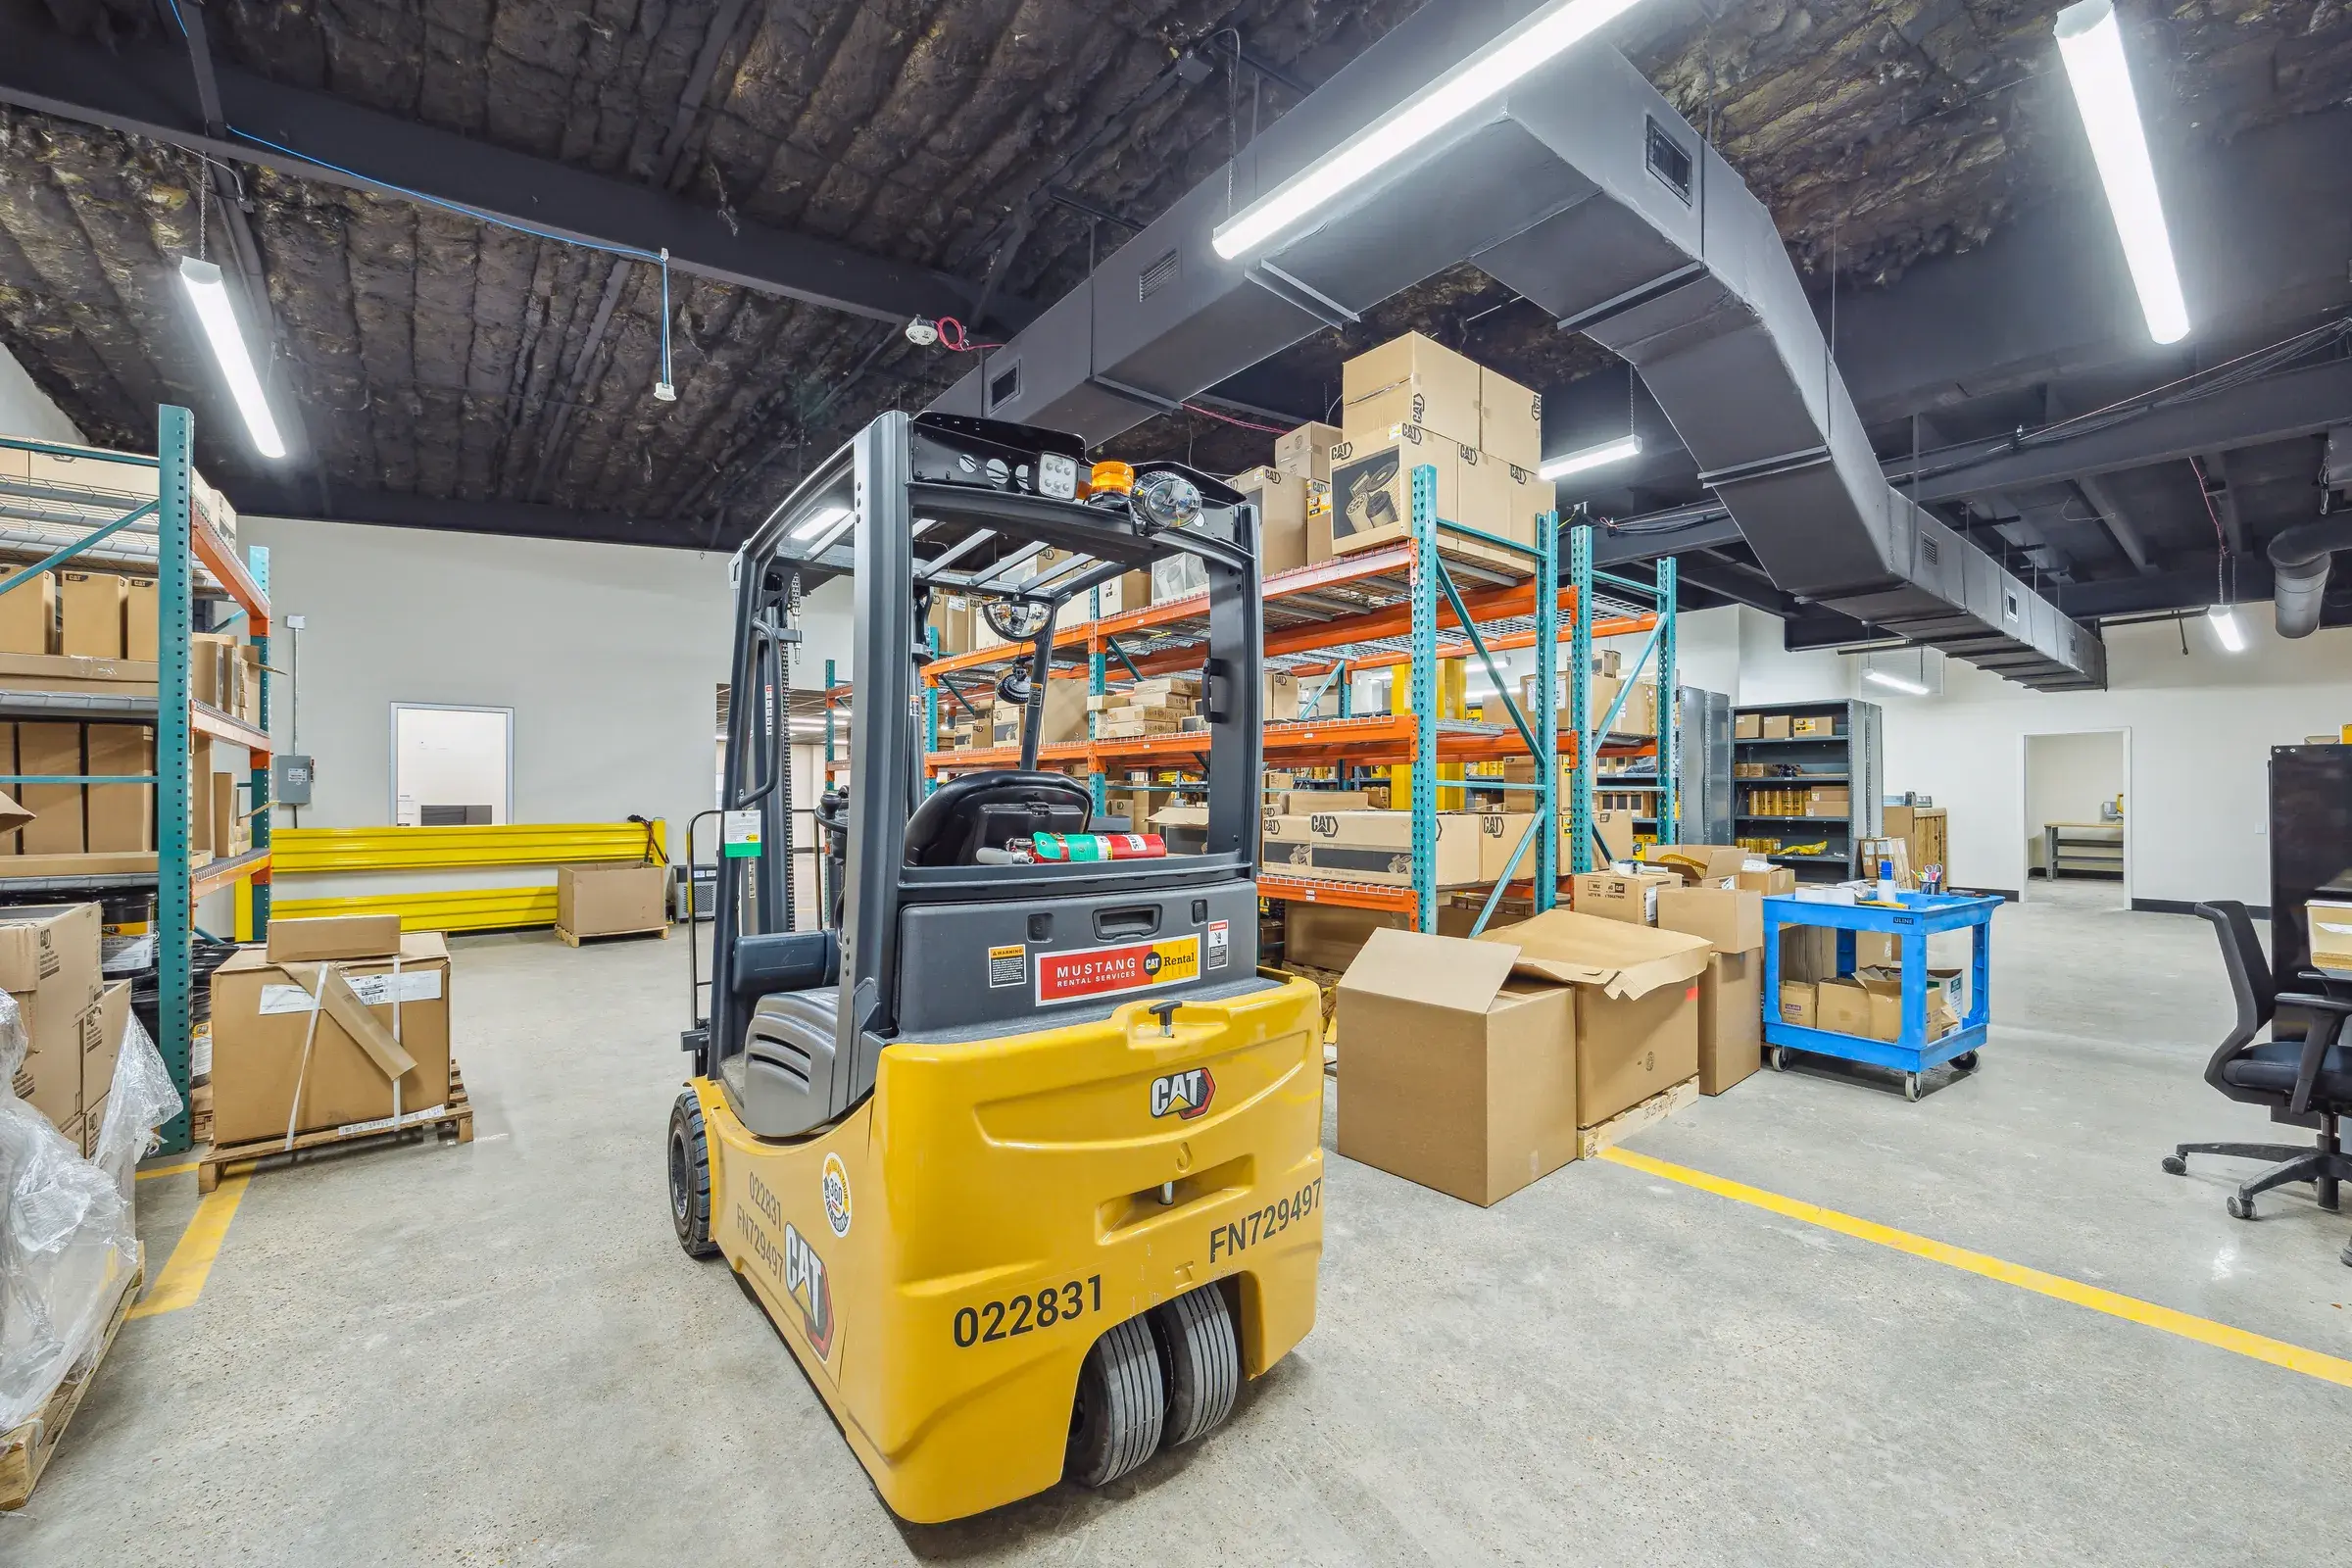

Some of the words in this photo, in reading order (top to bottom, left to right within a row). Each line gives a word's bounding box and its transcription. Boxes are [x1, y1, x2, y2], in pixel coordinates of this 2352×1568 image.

[1412, 399, 1424, 423] CAT
[1402, 422, 1418, 440] CAT
[1331, 443, 1348, 461] CAT
[1460, 444, 1476, 462] CAT
[1265, 469, 1278, 482] CAT
[1510, 465, 1526, 481] CAT
[1313, 481, 1325, 492] CAT
[1264, 819, 1277, 831] CAT
[1312, 815, 1332, 832] CAT
[1484, 816, 1499, 833] CAT
[1056, 957, 1136, 978] MUSTANG
[1146, 957, 1159, 969] CAT
[1163, 953, 1195, 967] Rental
[1056, 978, 1092, 988] RENTAL
[1096, 970, 1136, 982] SERVICES
[1152, 1069, 1201, 1116] CAT
[830, 1178, 842, 1206] 360
[750, 1171, 782, 1232] 022831
[1209, 1176, 1322, 1264] FN729497
[737, 1203, 784, 1284] FN729497
[785, 1223, 822, 1327] CAT
[953, 1274, 1102, 1348] 022831
